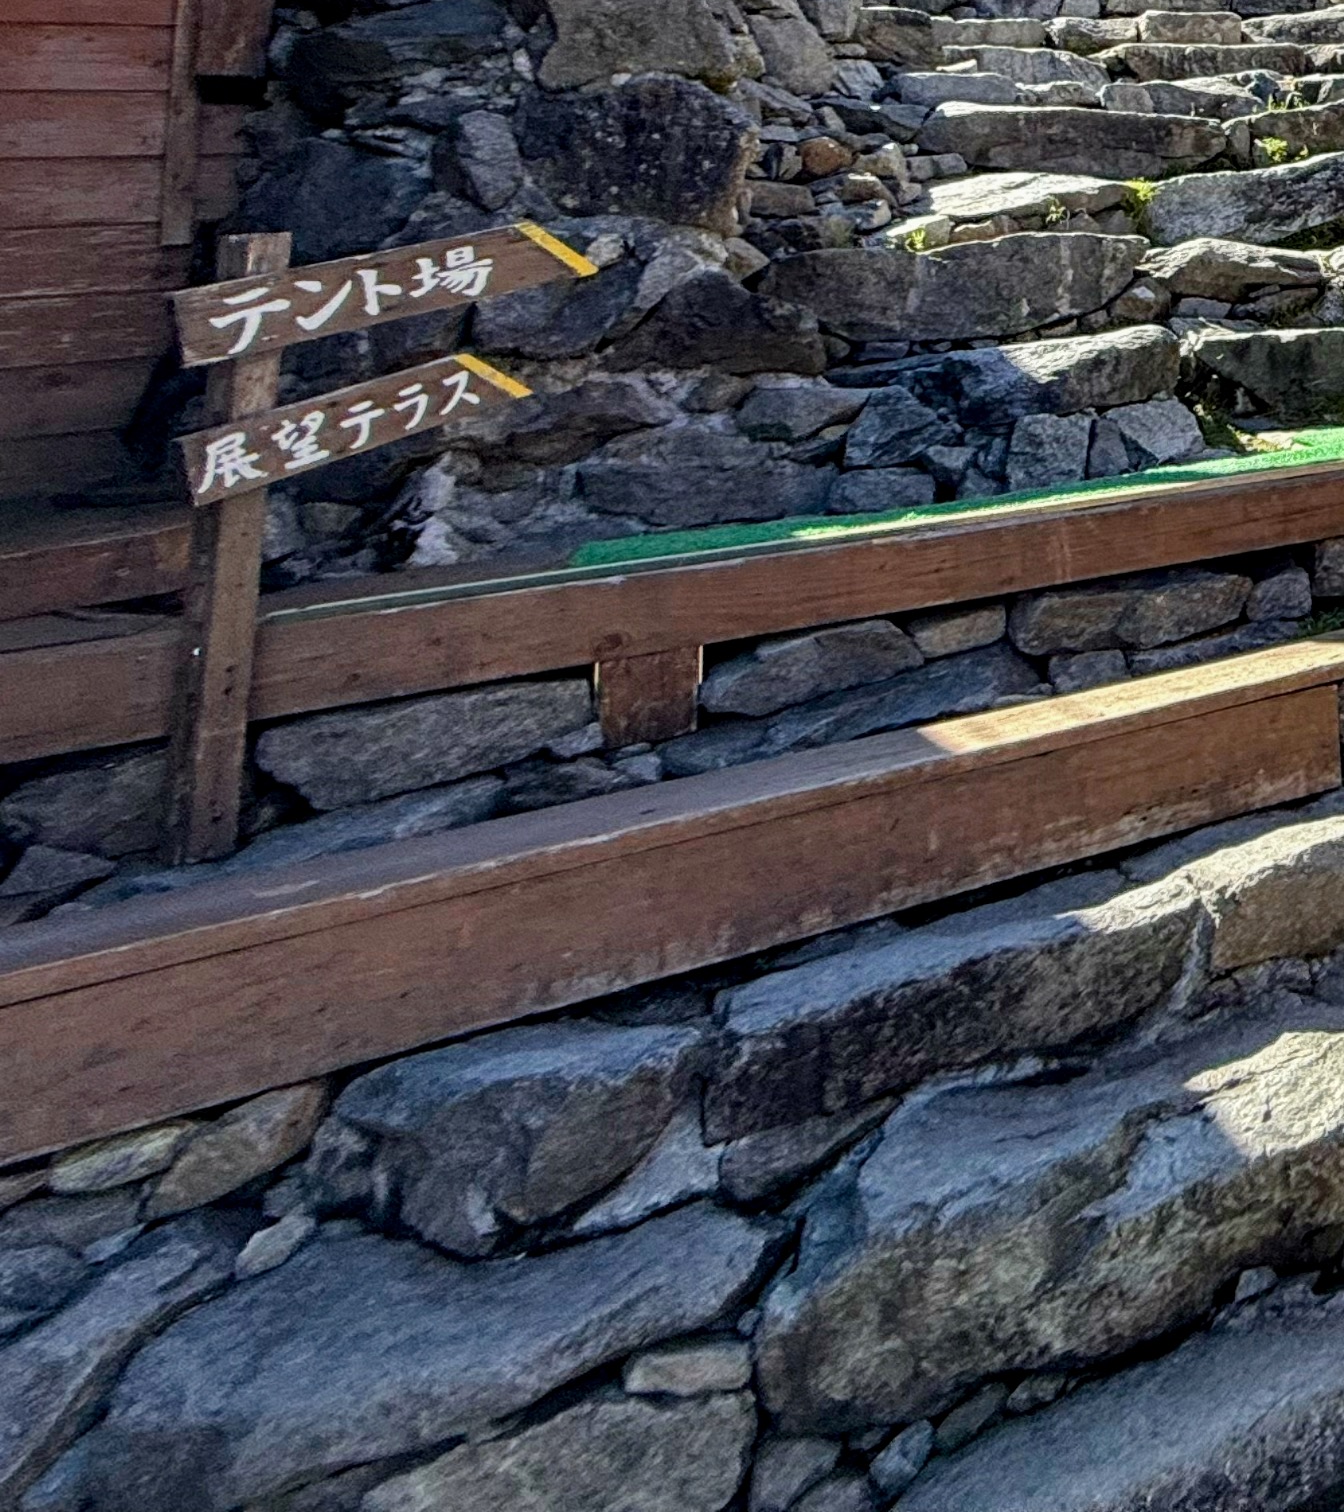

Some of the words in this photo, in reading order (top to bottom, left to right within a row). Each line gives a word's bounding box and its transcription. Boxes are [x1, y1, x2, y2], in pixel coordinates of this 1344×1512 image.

[208, 245, 493, 355] テント場
[197, 370, 480, 494] 展望テラス
